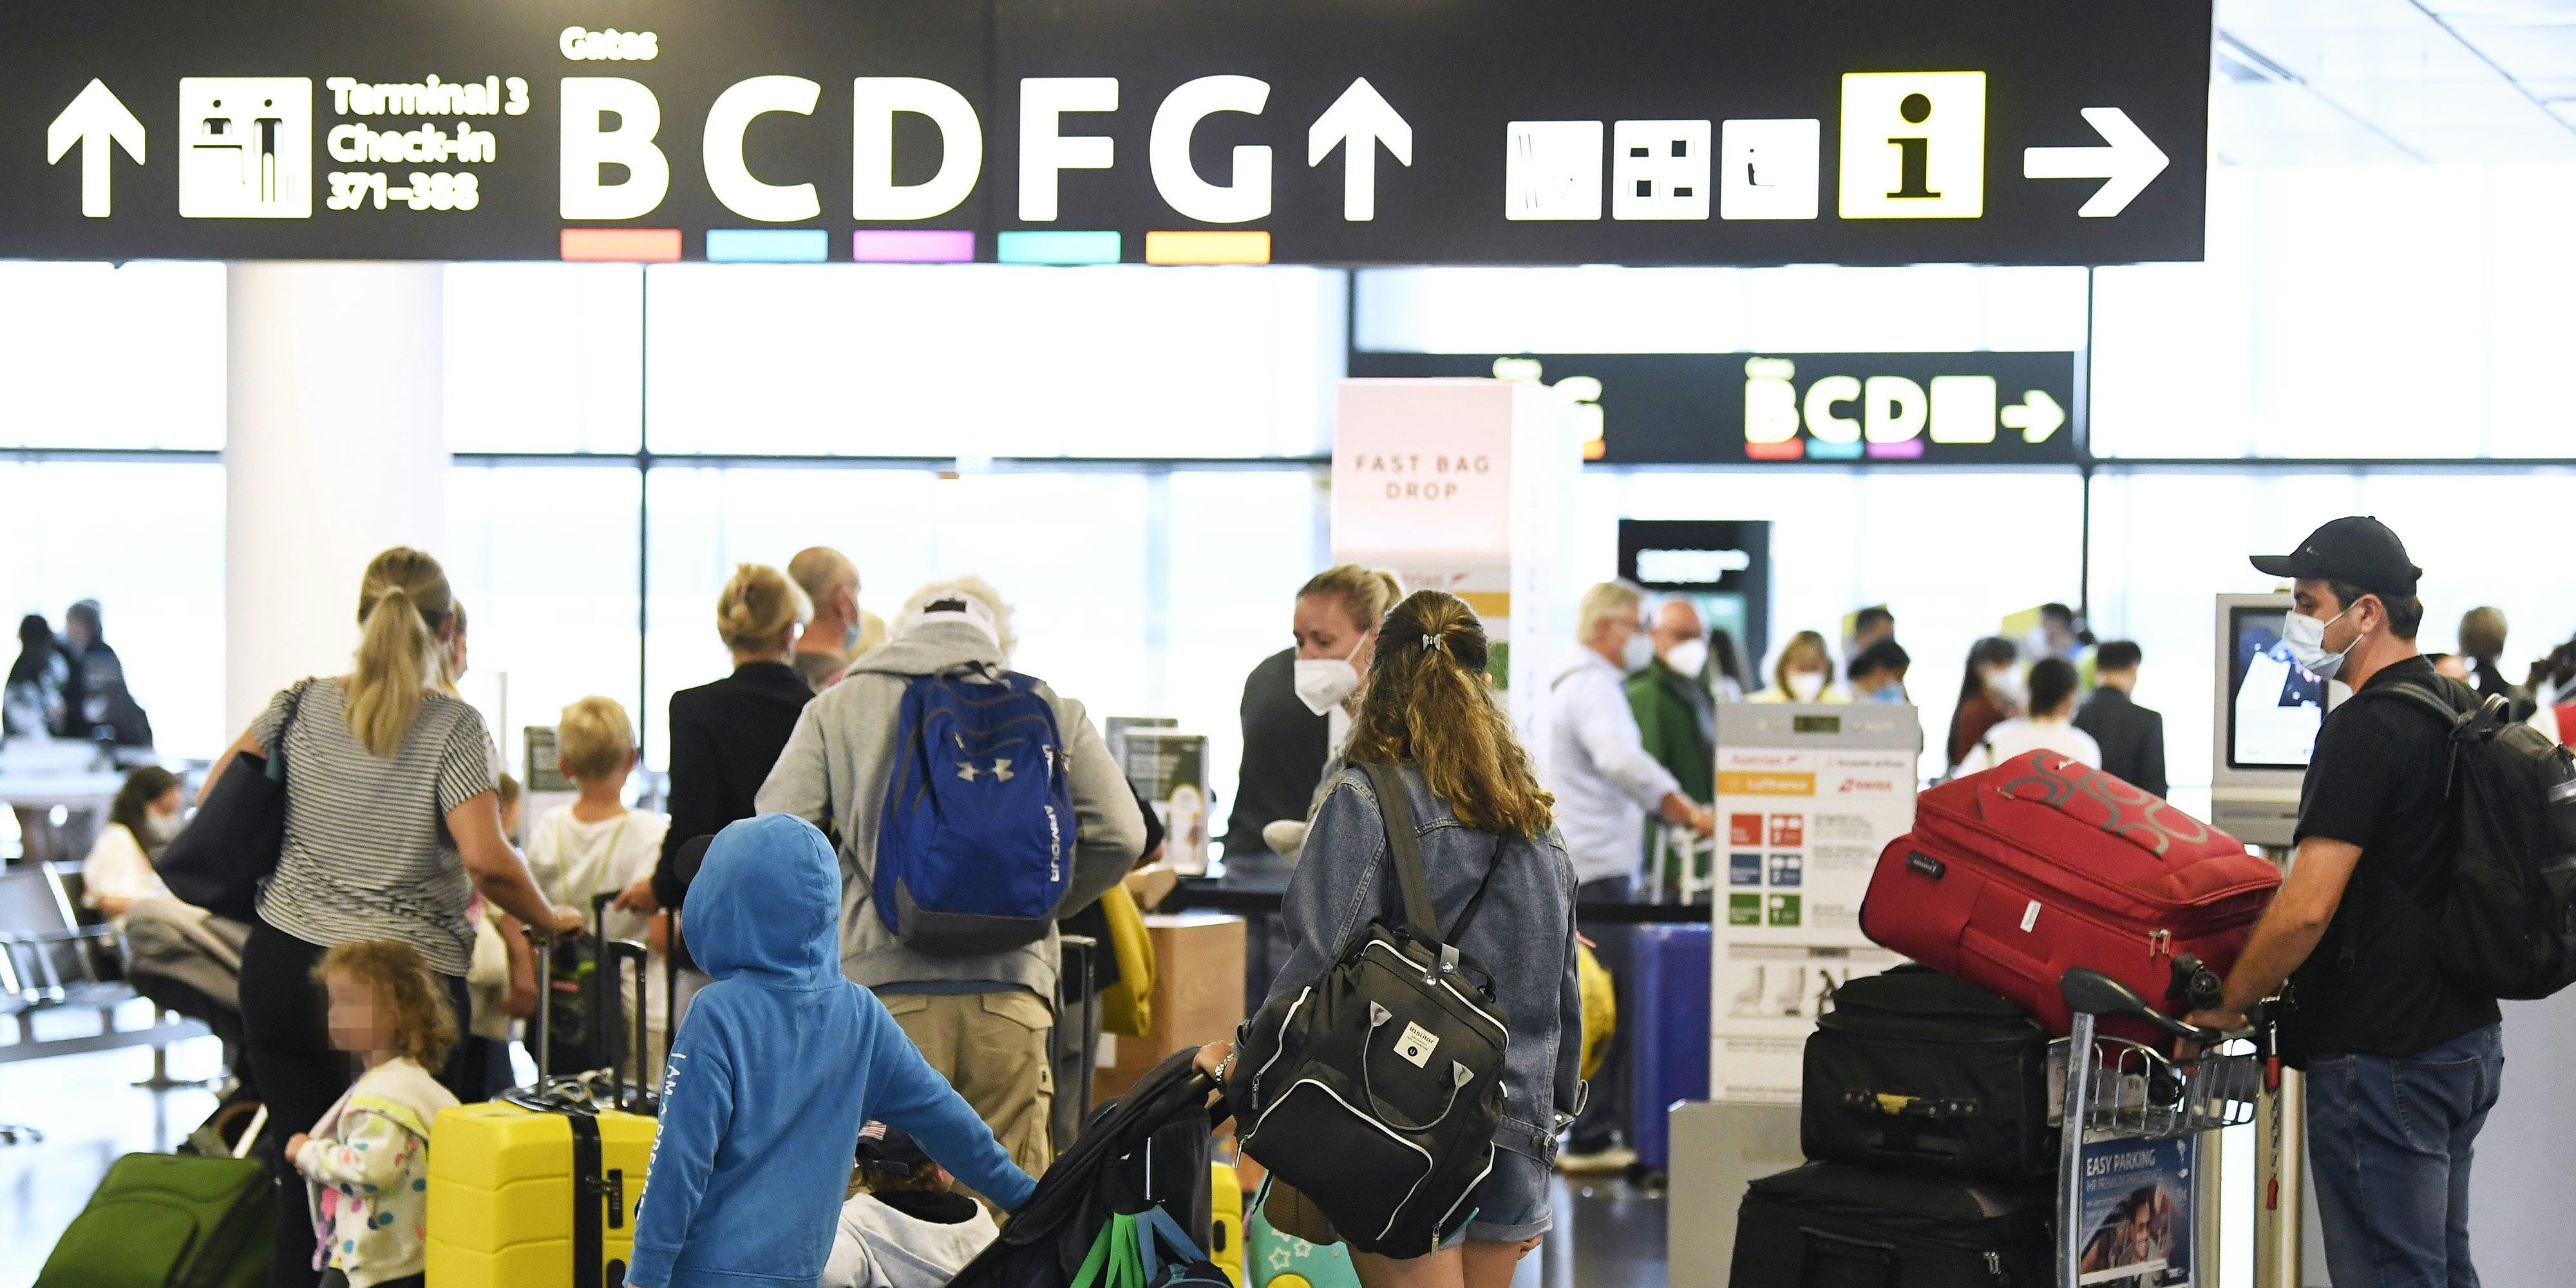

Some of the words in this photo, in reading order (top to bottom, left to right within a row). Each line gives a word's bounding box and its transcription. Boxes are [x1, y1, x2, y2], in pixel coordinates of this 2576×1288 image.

[559, 26, 659, 61] Gates
[327, 74, 500, 115] Terminal
[504, 77, 530, 115] 3
[327, 121, 496, 163] Check-in
[560, 77, 670, 220] B
[703, 75, 821, 222] C
[852, 77, 983, 220] D
[1018, 77, 1119, 222] F
[1149, 75, 1273, 223] G
[1804, 375, 1861, 444] C
[1864, 375, 1927, 443] D
[1355, 454, 1420, 474] FAST
[1436, 454, 1491, 474] BAG
[1385, 482, 1459, 500] DROP
[664, 1065, 681, 1096] AM
[2087, 1155, 2113, 1177] EASY
[2114, 1149, 2156, 1172] PARKING
